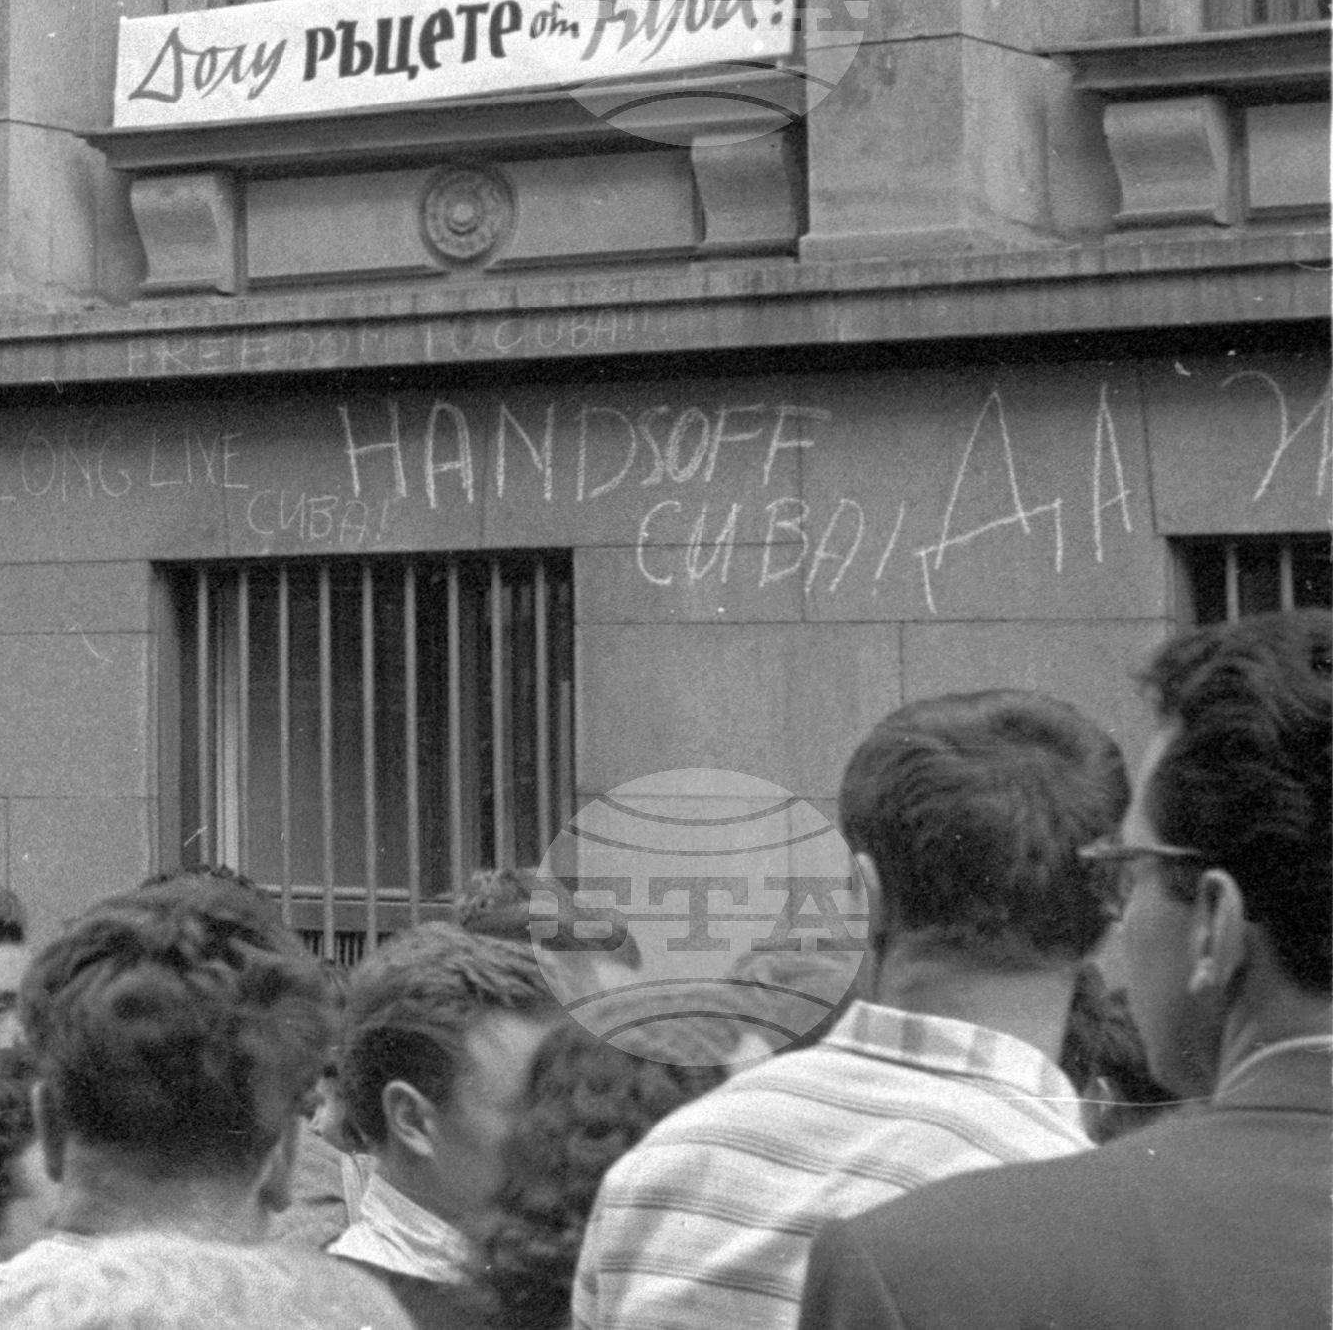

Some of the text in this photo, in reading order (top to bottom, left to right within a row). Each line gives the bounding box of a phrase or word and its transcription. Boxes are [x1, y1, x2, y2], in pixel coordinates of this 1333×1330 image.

[129, 26, 288, 103] Долу
[149, 429, 249, 488] LIVE
[247, 490, 389, 546] CUBA!
[638, 498, 906, 596] CUBA!
